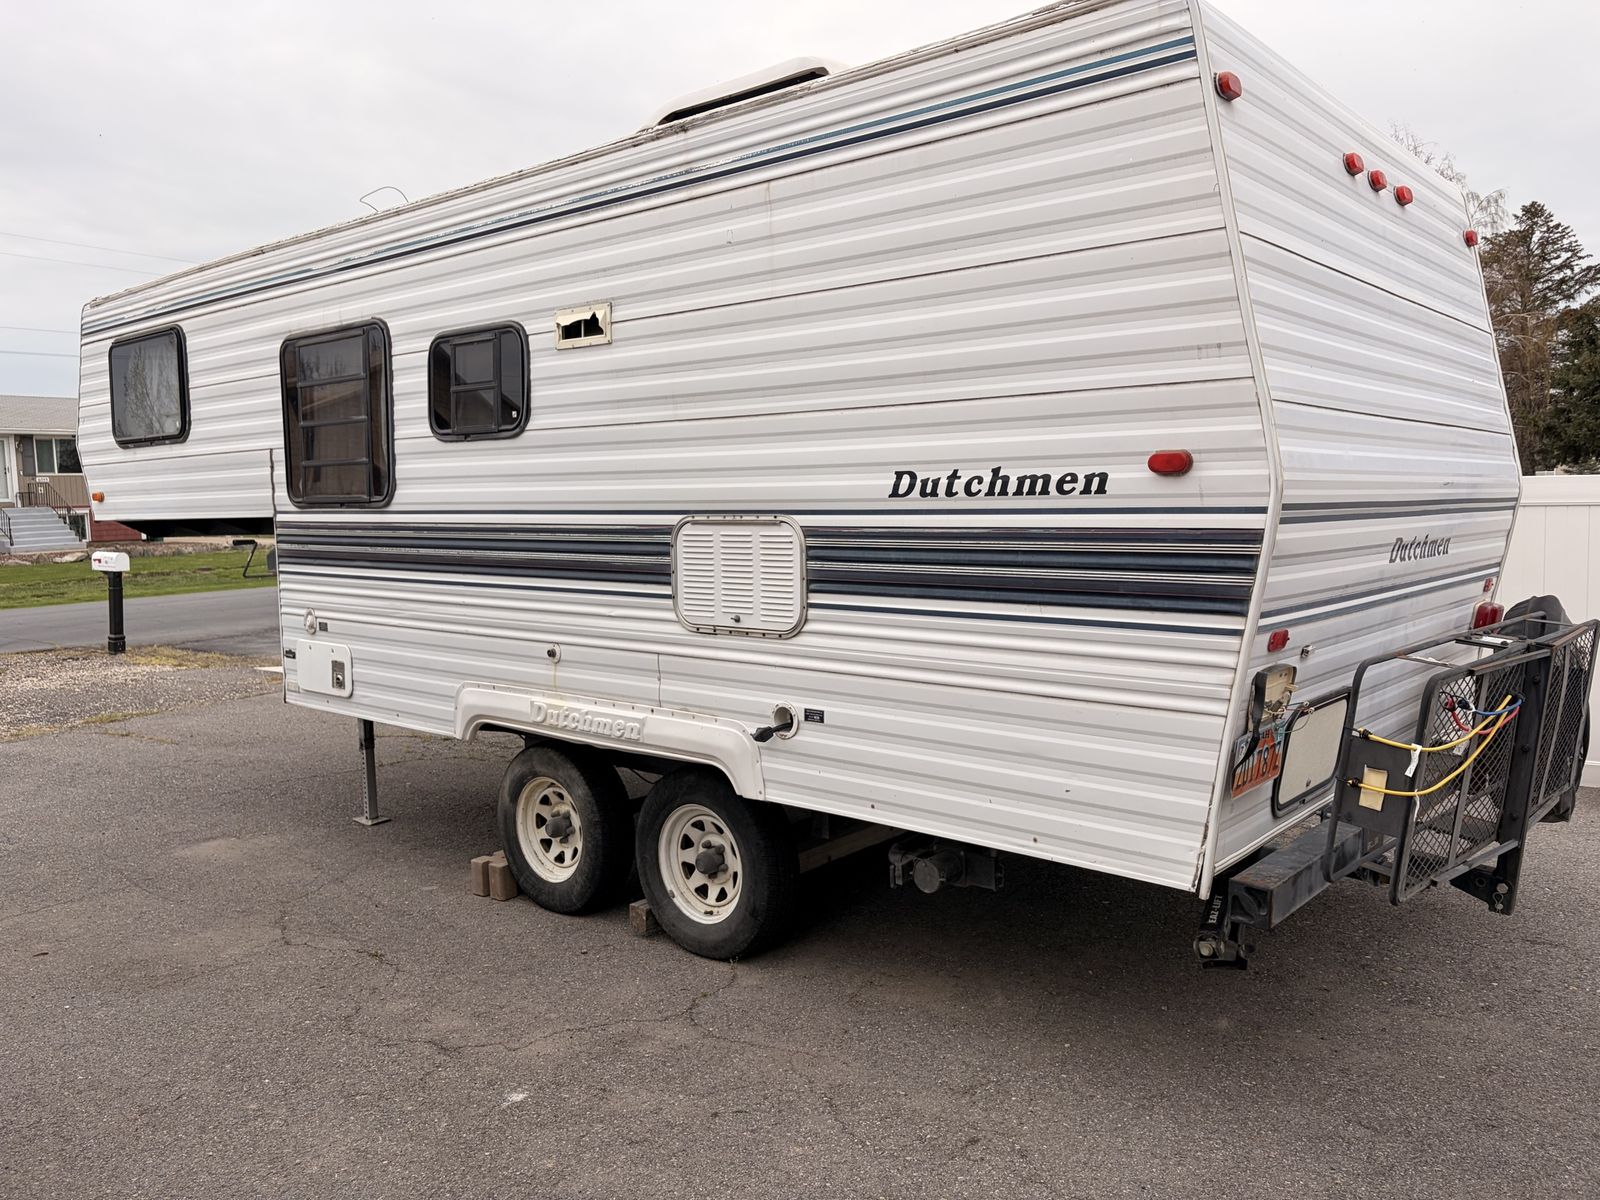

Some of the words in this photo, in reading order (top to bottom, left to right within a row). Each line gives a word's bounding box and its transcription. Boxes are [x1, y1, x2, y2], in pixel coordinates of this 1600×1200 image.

[888, 466, 1110, 498] Dutchmen
[1388, 533, 1452, 564] Dutchmen
[532, 701, 641, 741] Dutchmen
